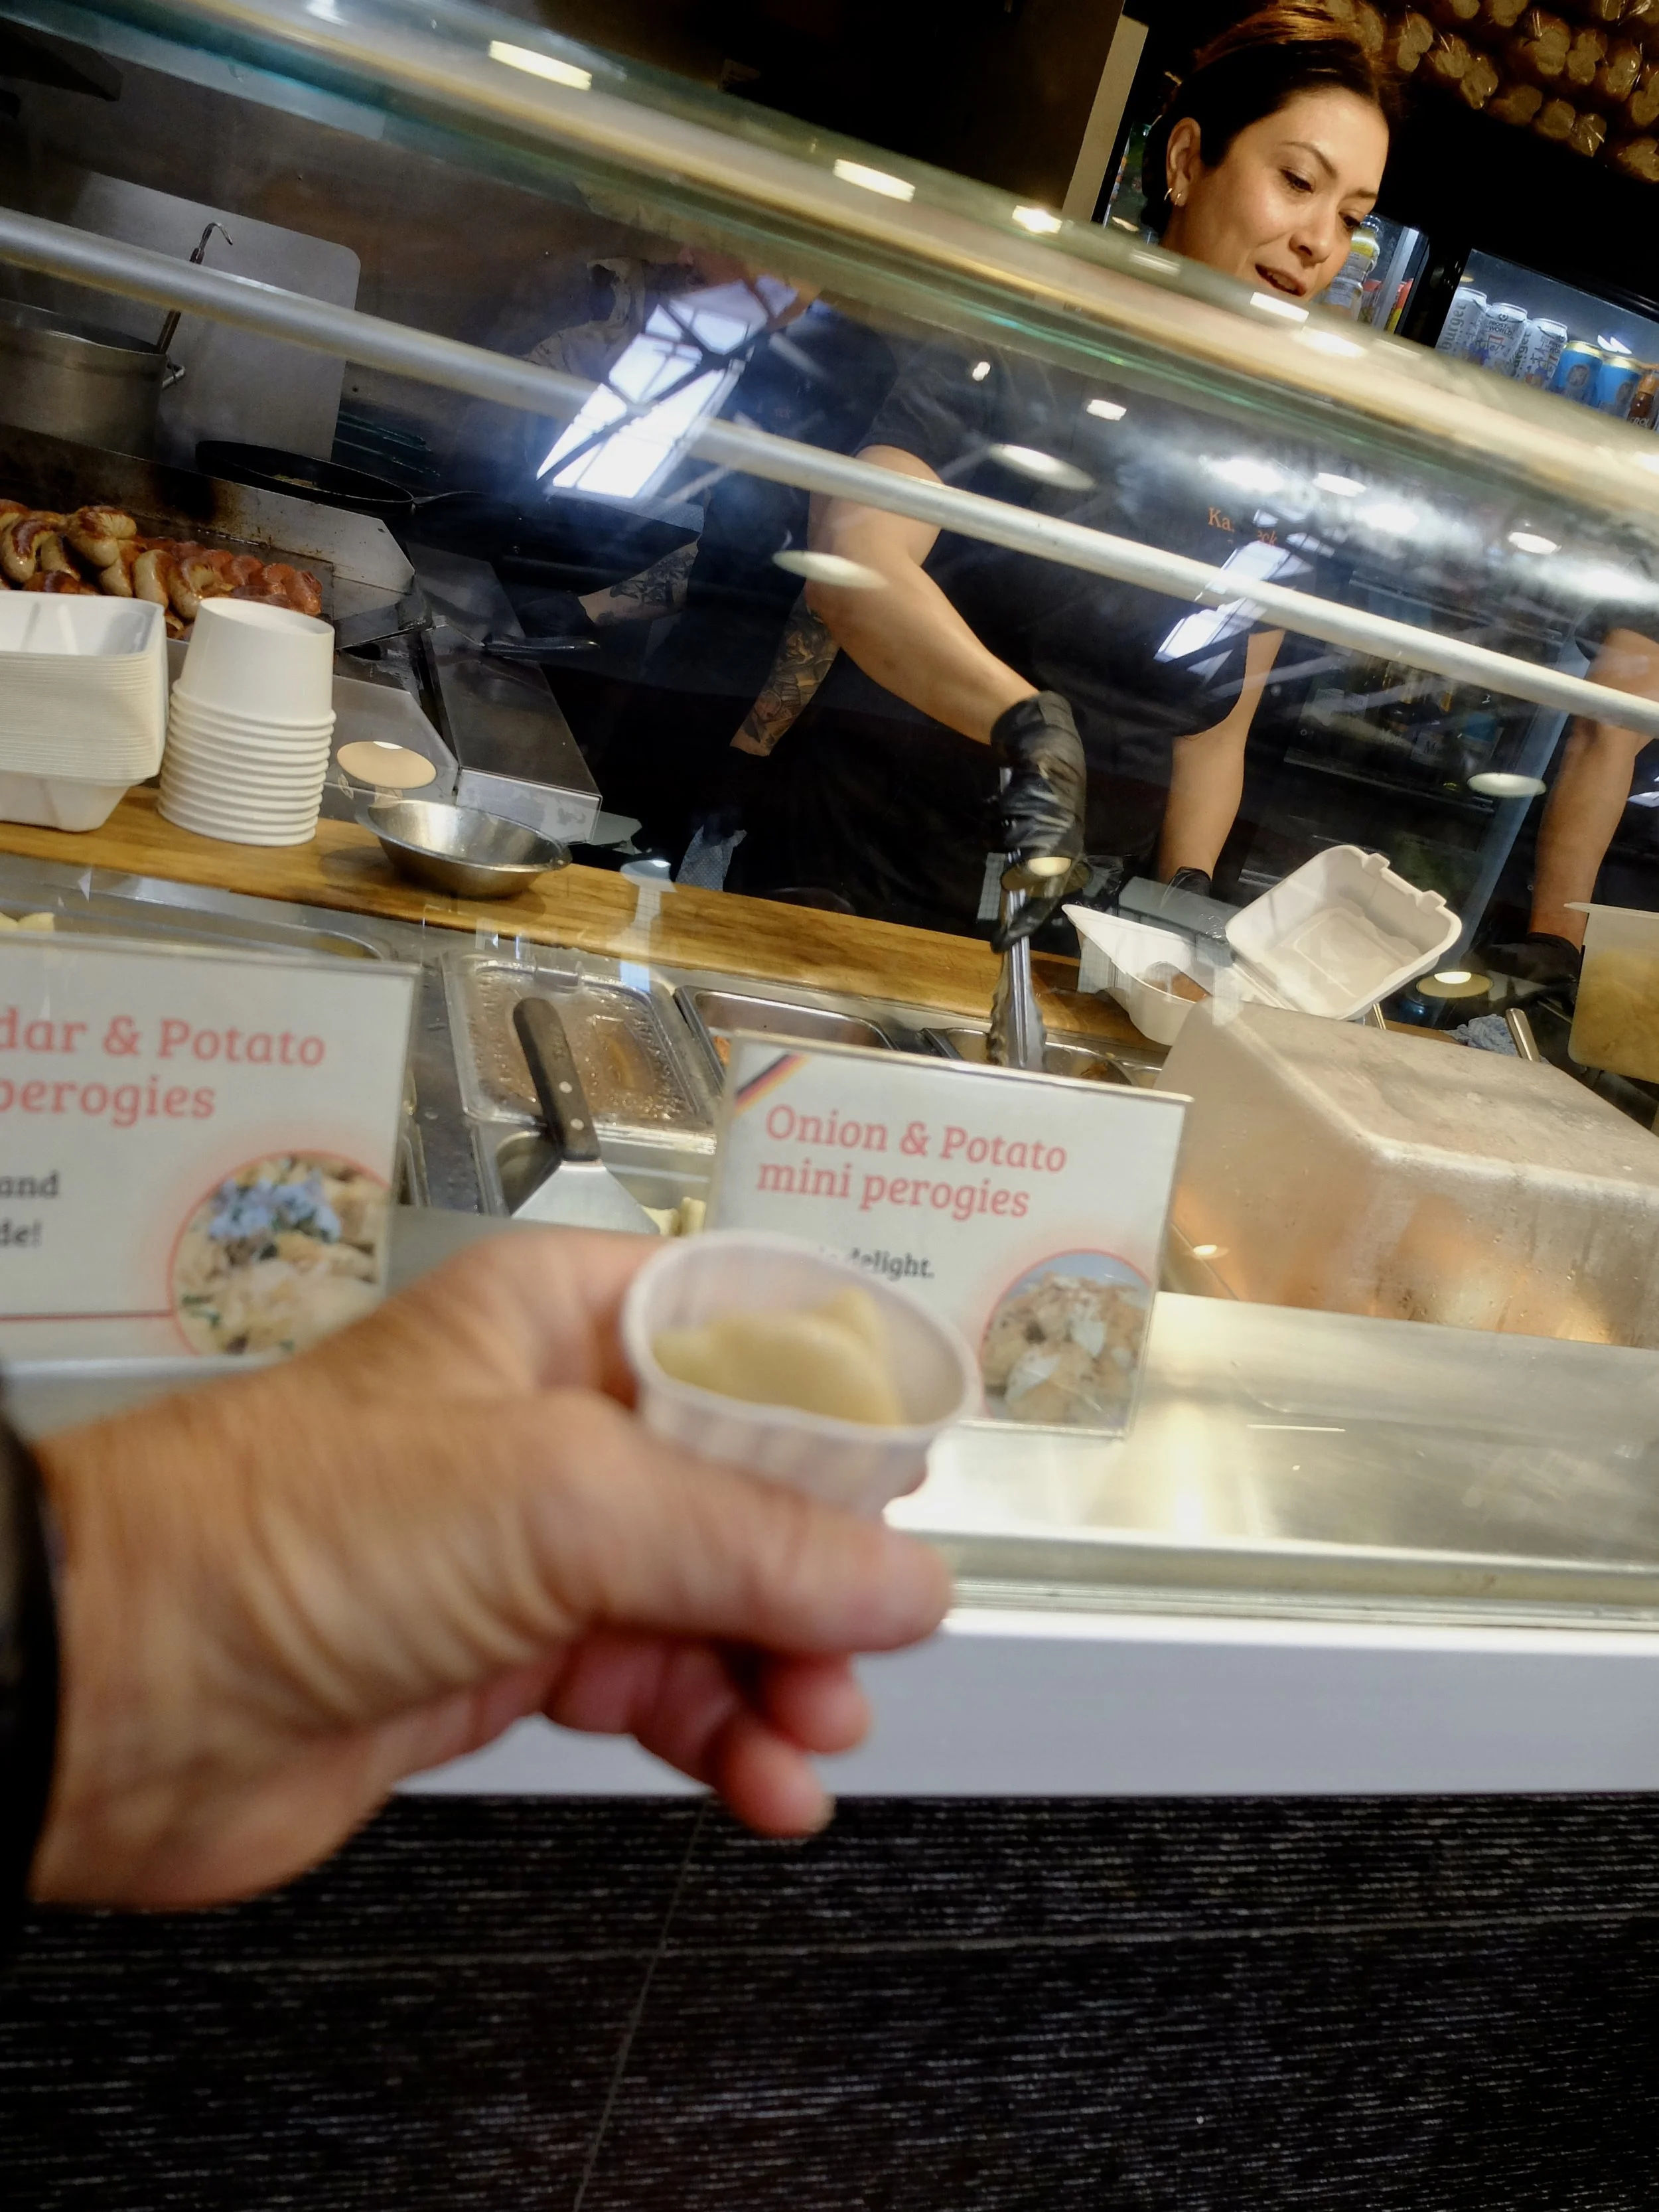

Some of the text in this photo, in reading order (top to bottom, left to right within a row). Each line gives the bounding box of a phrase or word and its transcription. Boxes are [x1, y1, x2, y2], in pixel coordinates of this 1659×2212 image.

[102, 1015, 141, 1057] &
[158, 1017, 326, 1067] Potato
[764, 1104, 1068, 1173] Onion & Potato
[757, 1160, 1031, 1222] mini perogies
